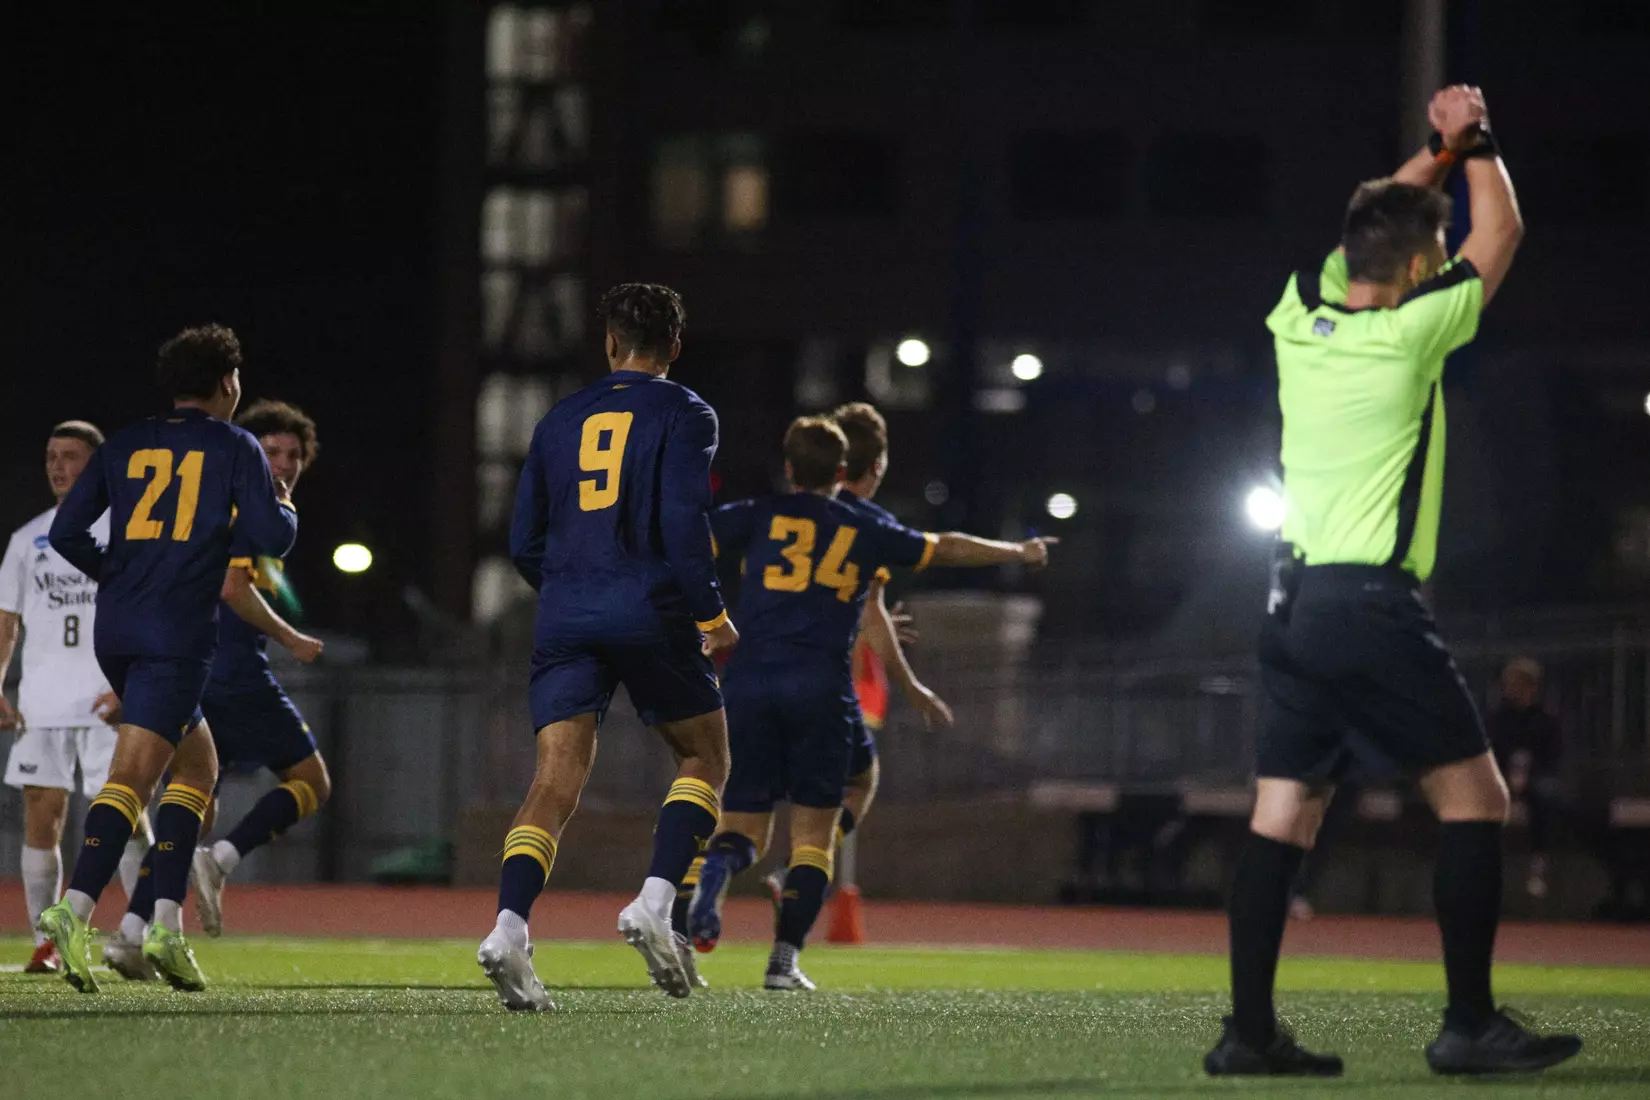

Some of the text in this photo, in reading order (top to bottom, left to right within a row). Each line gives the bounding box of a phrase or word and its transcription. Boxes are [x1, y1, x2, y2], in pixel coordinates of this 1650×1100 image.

[125, 449, 204, 541] 21
[578, 411, 634, 511] 9
[763, 515, 860, 603] 34
[64, 614, 79, 647] 8
